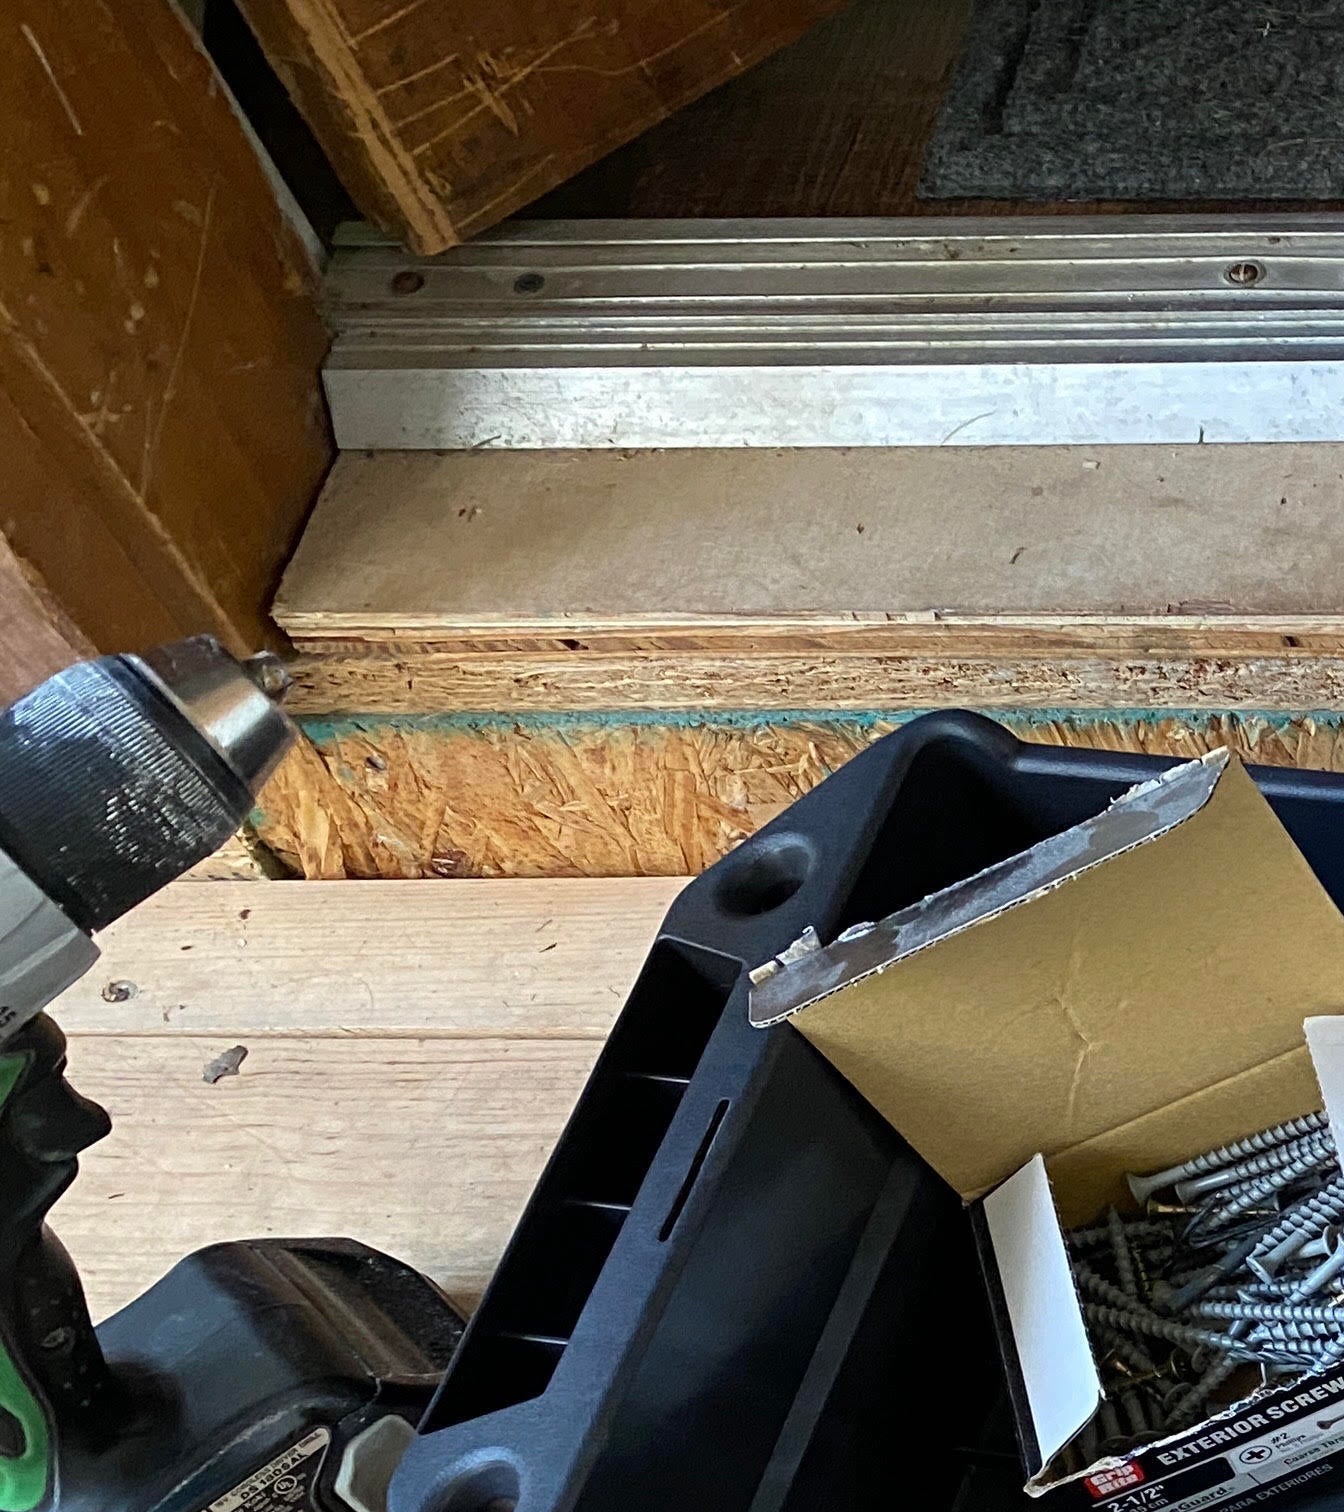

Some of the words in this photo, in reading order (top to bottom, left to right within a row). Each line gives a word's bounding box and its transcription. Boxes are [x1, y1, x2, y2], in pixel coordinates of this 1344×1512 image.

[1156, 1412, 1270, 1466] EXTERIOR
[1269, 1431, 1289, 1445] #2
[239, 1484, 258, 1500] DS
[1254, 1461, 1334, 1501] EXTERIORES
